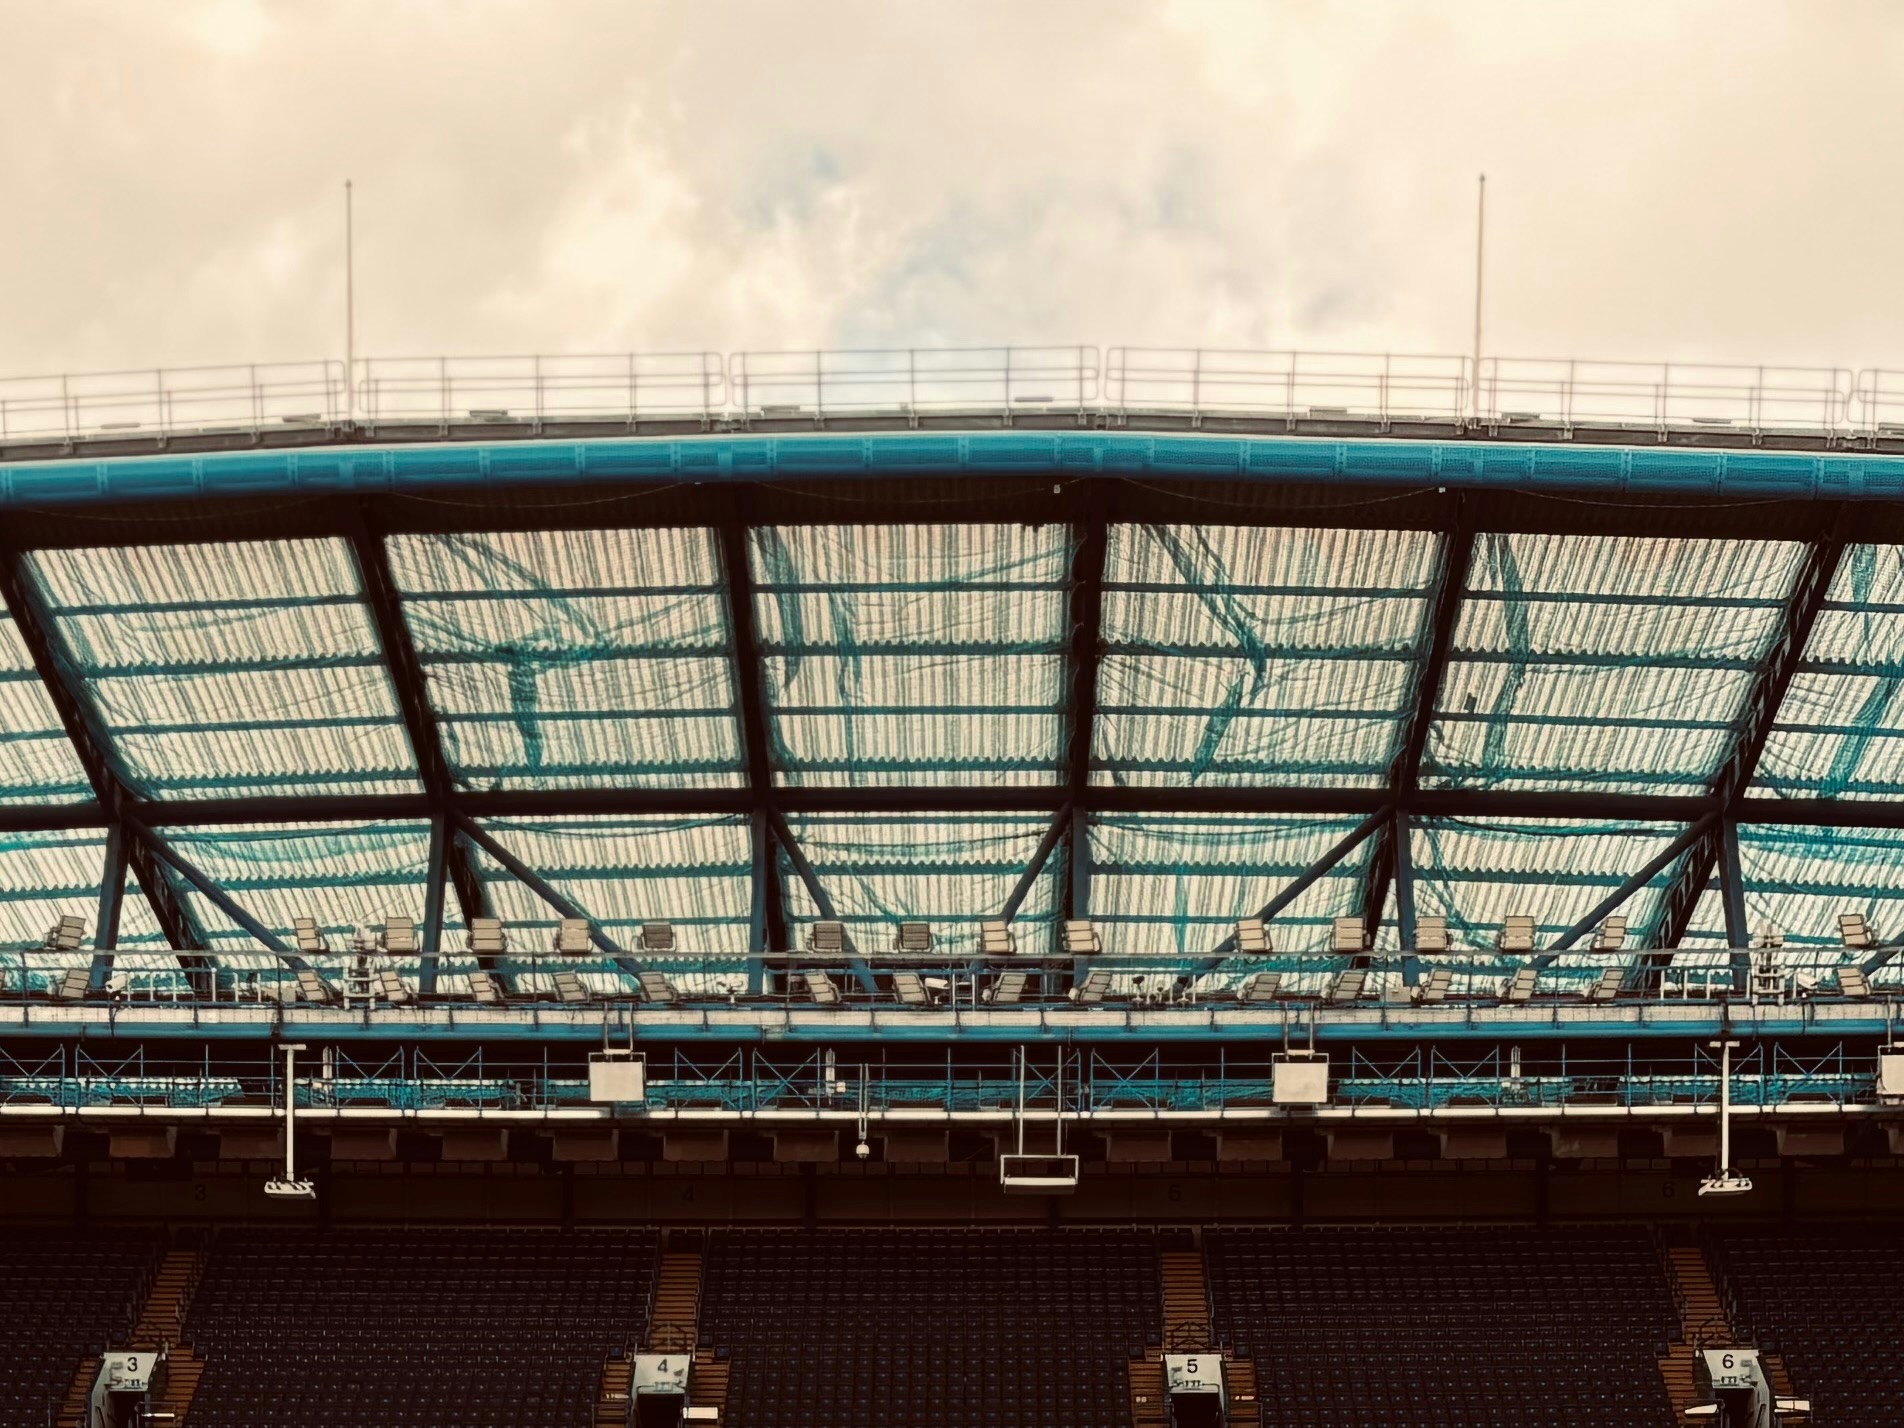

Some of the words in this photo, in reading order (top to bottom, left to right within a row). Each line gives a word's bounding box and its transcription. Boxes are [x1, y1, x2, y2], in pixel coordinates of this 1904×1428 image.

[194, 1183, 207, 1201] 3
[682, 1183, 695, 1202] 4
[1168, 1184, 1181, 1202] 5
[1662, 1181, 1674, 1198] 6
[127, 1357, 138, 1372] 3
[657, 1358, 668, 1373] 4
[1187, 1359, 1198, 1374] 5
[1722, 1354, 1734, 1369] 6
